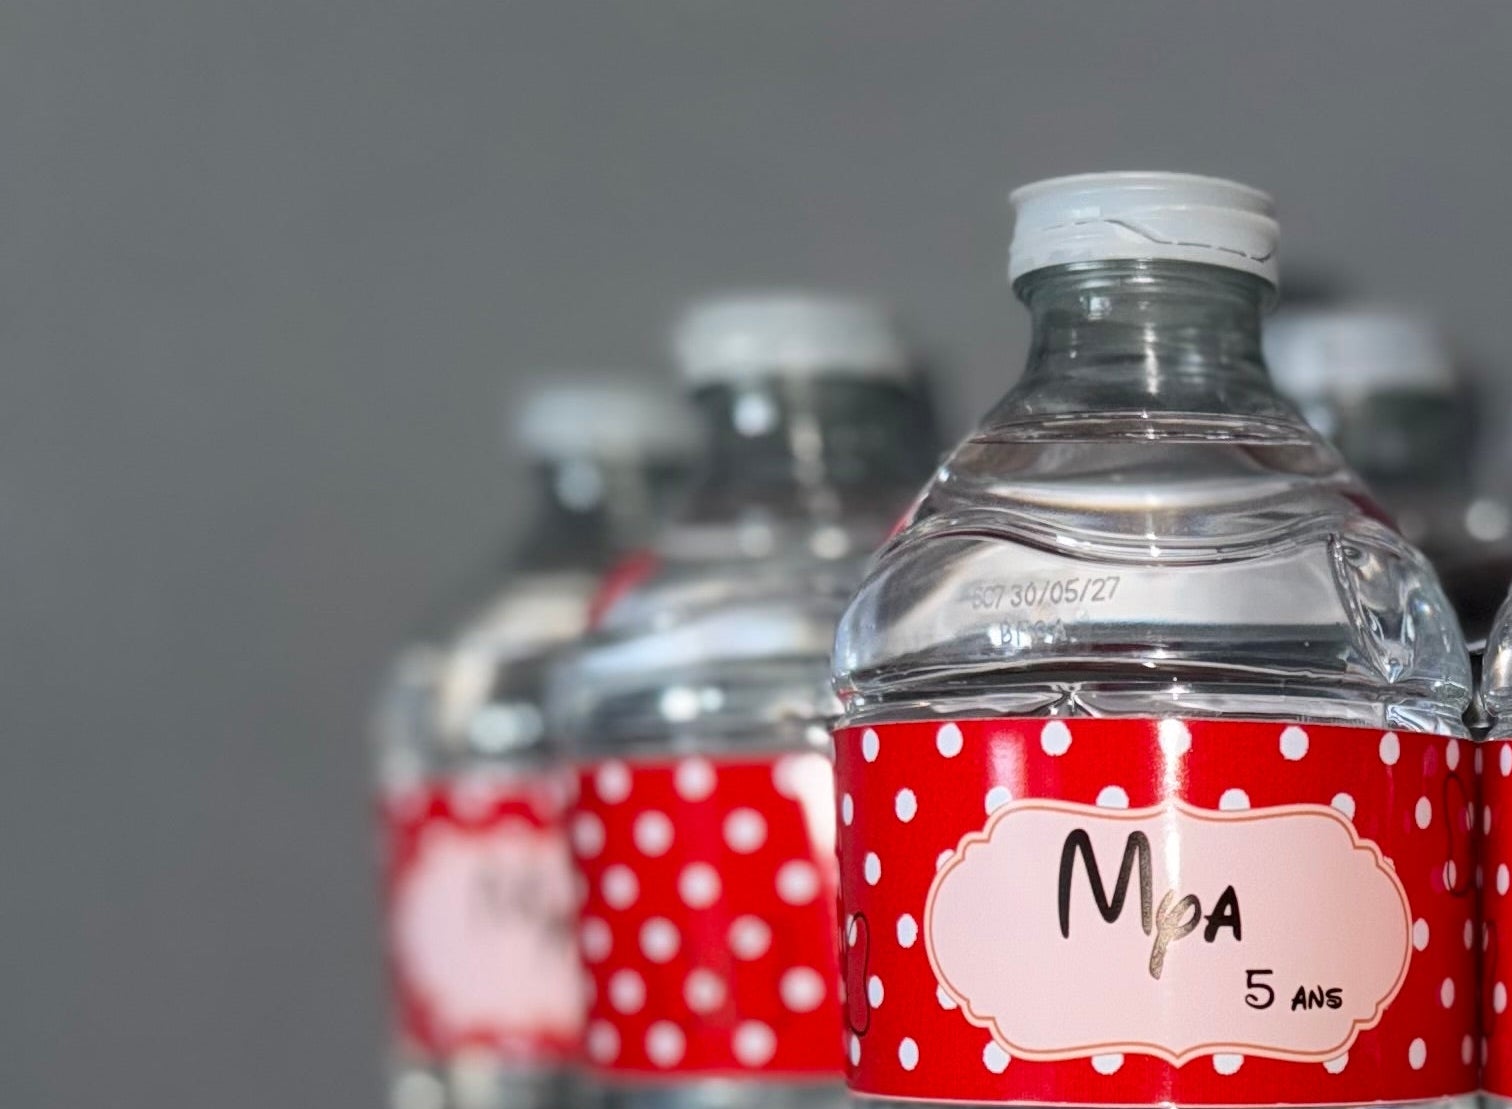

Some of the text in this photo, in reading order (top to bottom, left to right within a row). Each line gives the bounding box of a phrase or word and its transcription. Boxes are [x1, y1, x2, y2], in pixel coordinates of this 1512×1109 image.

[1010, 576, 1121, 607] 30/05/27
[1244, 969, 1344, 1012] 5 ANS
